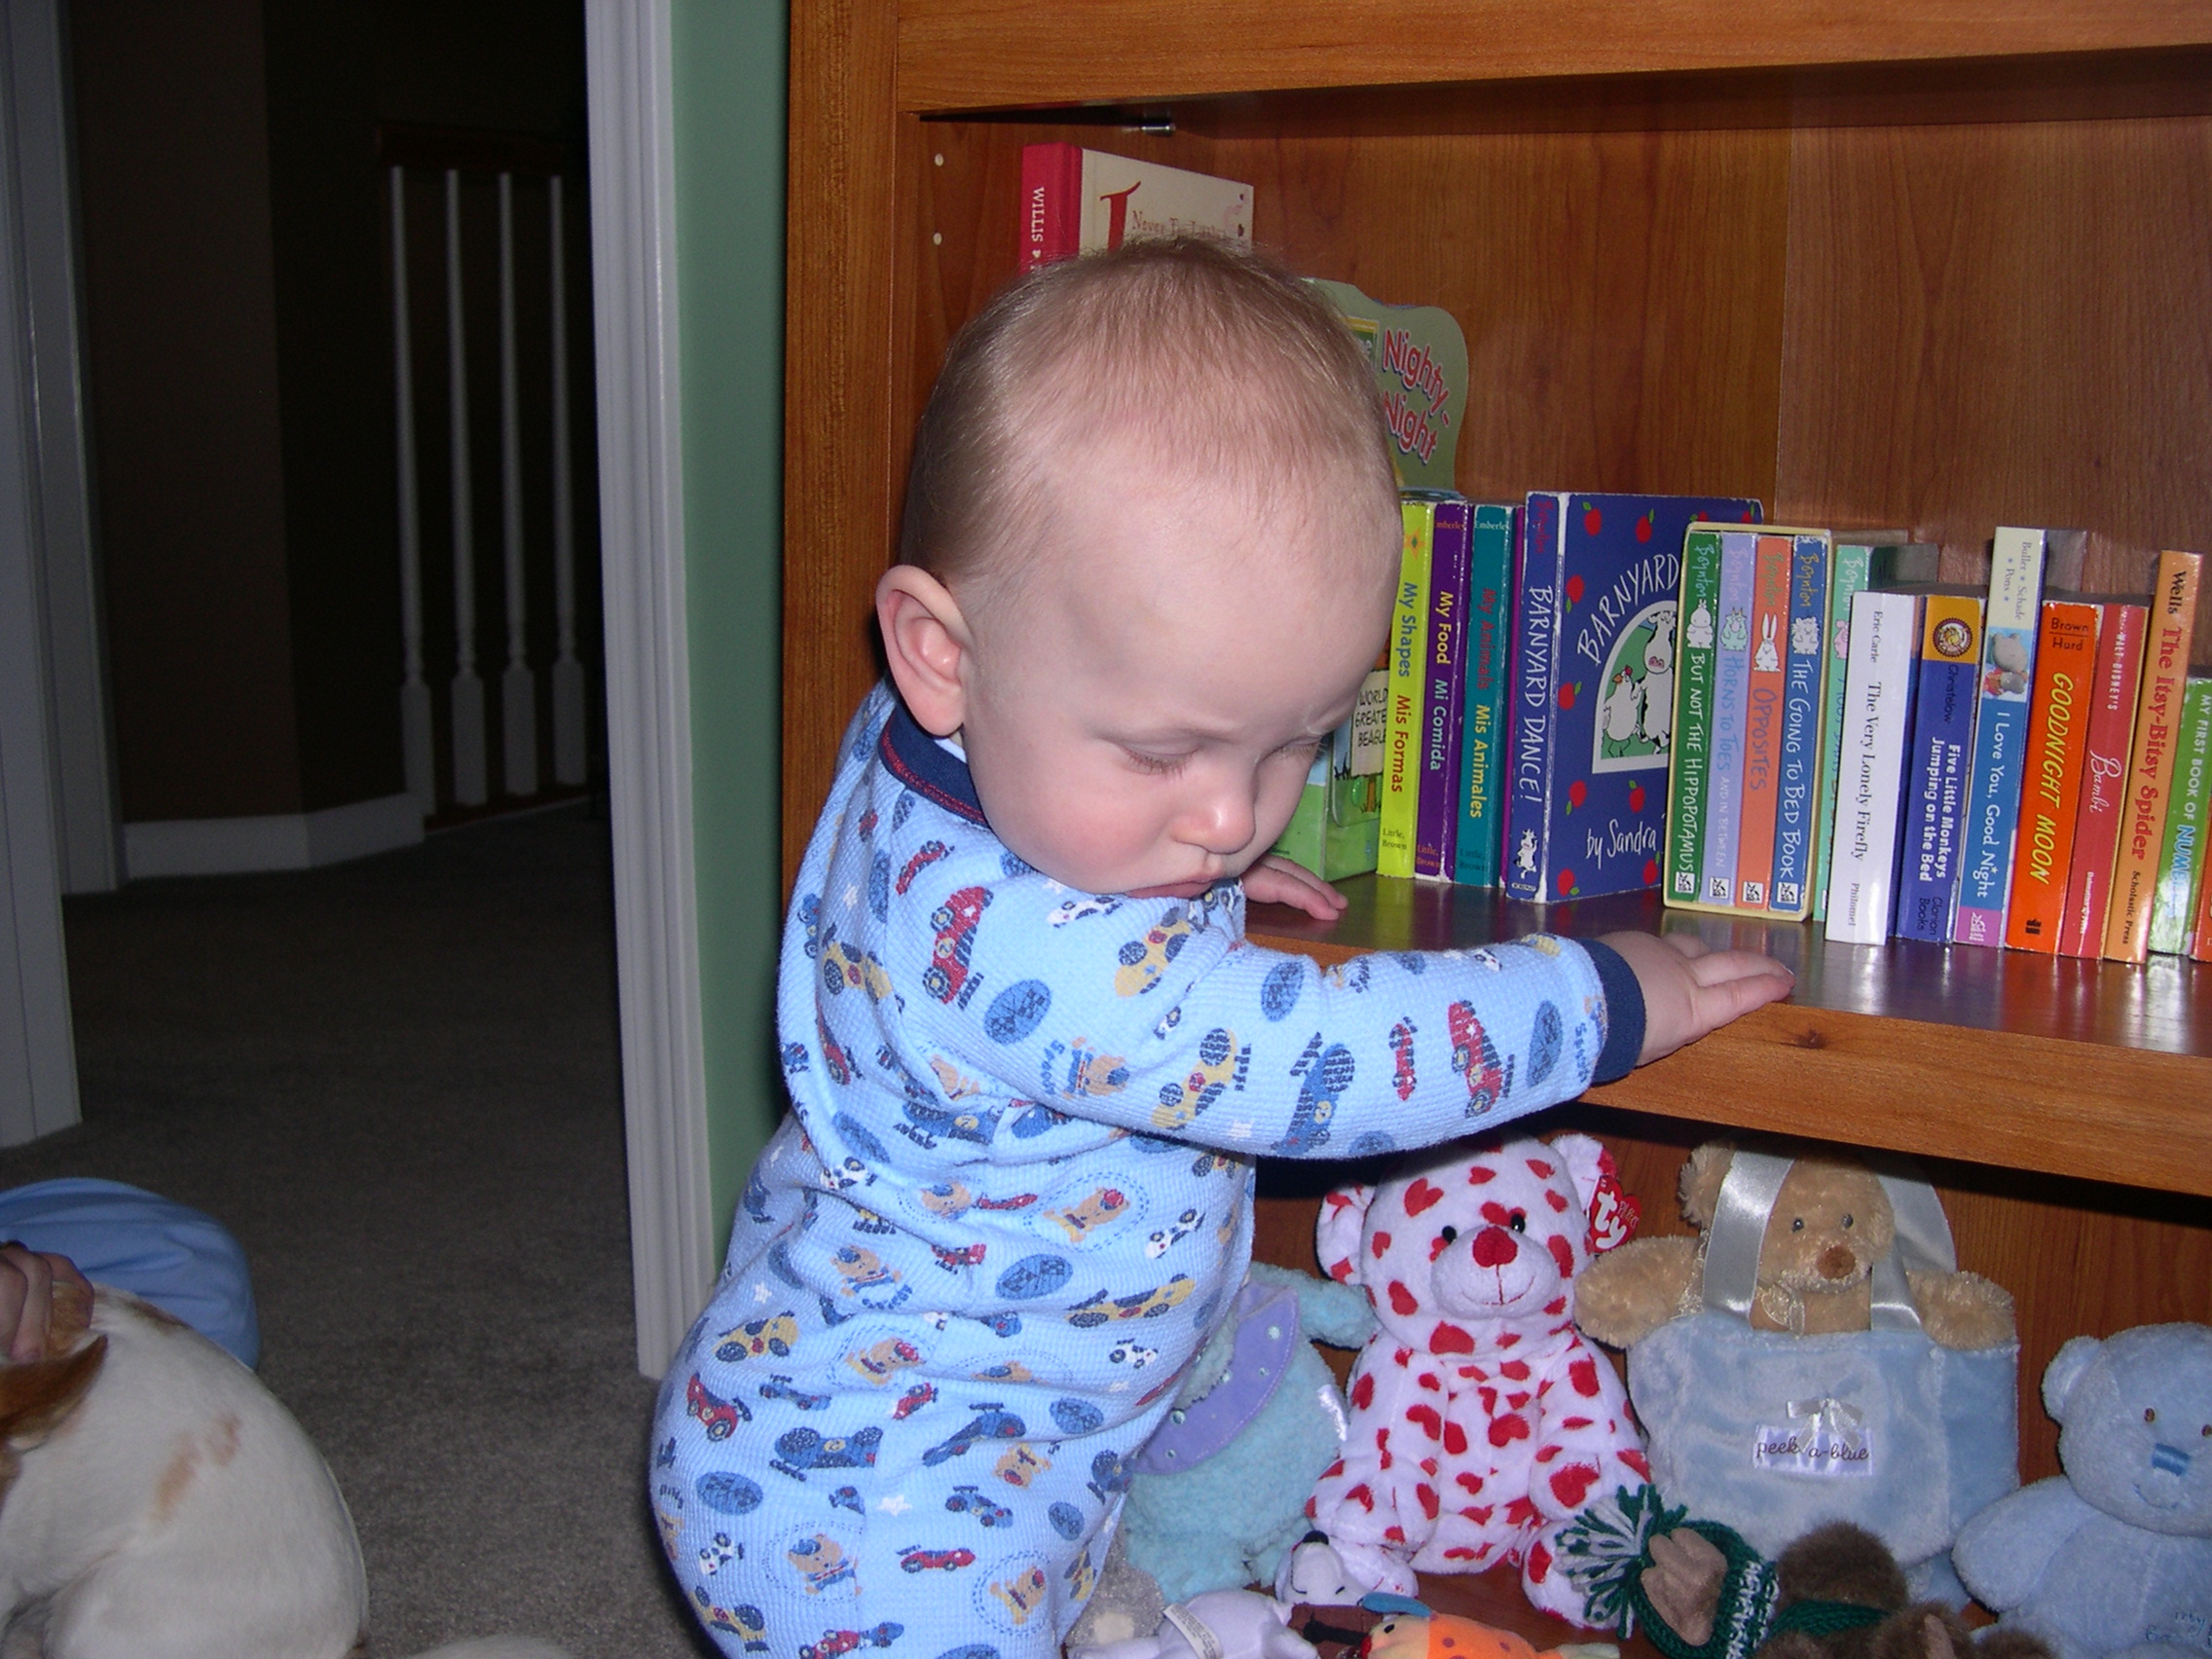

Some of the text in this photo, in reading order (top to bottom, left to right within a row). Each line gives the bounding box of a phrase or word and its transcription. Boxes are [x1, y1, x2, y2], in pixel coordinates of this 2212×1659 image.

[1031, 186, 1045, 241] WILLIS
[1382, 390, 1439, 464] Night
[1692, 543, 1714, 598] Boynton
[1796, 553, 1820, 608] Boynton
[1576, 553, 1679, 667] BARNYARD
[2050, 617, 2088, 632] Brown
[2051, 637, 2083, 651] Hurd
[1390, 582, 1418, 793] My Shapes Mis Formas
[1429, 591, 1454, 771] My Food Mi Comida
[1519, 584, 1553, 802] BARNYARD DANCE!
[1721, 655, 1745, 710] HORNS
[2107, 634, 2127, 711] WALT DISNEY'S
[1469, 588, 1496, 818] My Animals Mis Animales
[1719, 715, 1735, 730] TO
[2199, 694, 2212, 715] MY
[1677, 652, 1706, 874] BUT NOT THE HIPPOPOTAMUS
[1716, 734, 1739, 771] TOES
[1750, 687, 1777, 791] OPPOSITES
[1991, 721, 2010, 760] Love
[2121, 571, 2187, 944] Wells The Itsy-Bitsy Spider Scholastic Press
[2194, 719, 2209, 755] FIRST
[1719, 777, 1730, 799] AND
[1780, 659, 1814, 879] THE GOING TO BED BOOK
[1848, 610, 1883, 927] Eric Carle The Very Lonely Firefly Philomel
[1986, 764, 2005, 799] You,
[2028, 672, 2074, 886] GOODNIGHT MOON
[2089, 750, 2122, 814] Bambi
[2187, 757, 2203, 798] BOOK
[1919, 736, 1945, 882] Jumping on the Bed
[1936, 744, 1961, 879] Five Little Monkeys
[1982, 803, 2001, 846] Good
[2184, 801, 2196, 821] OF
[1585, 818, 1656, 869] by Sandra
[1715, 817, 1729, 867] BETWEEN
[1972, 850, 1998, 899] Night
[1917, 897, 1931, 932] Books
[1595, 1190, 1627, 1250] ty
